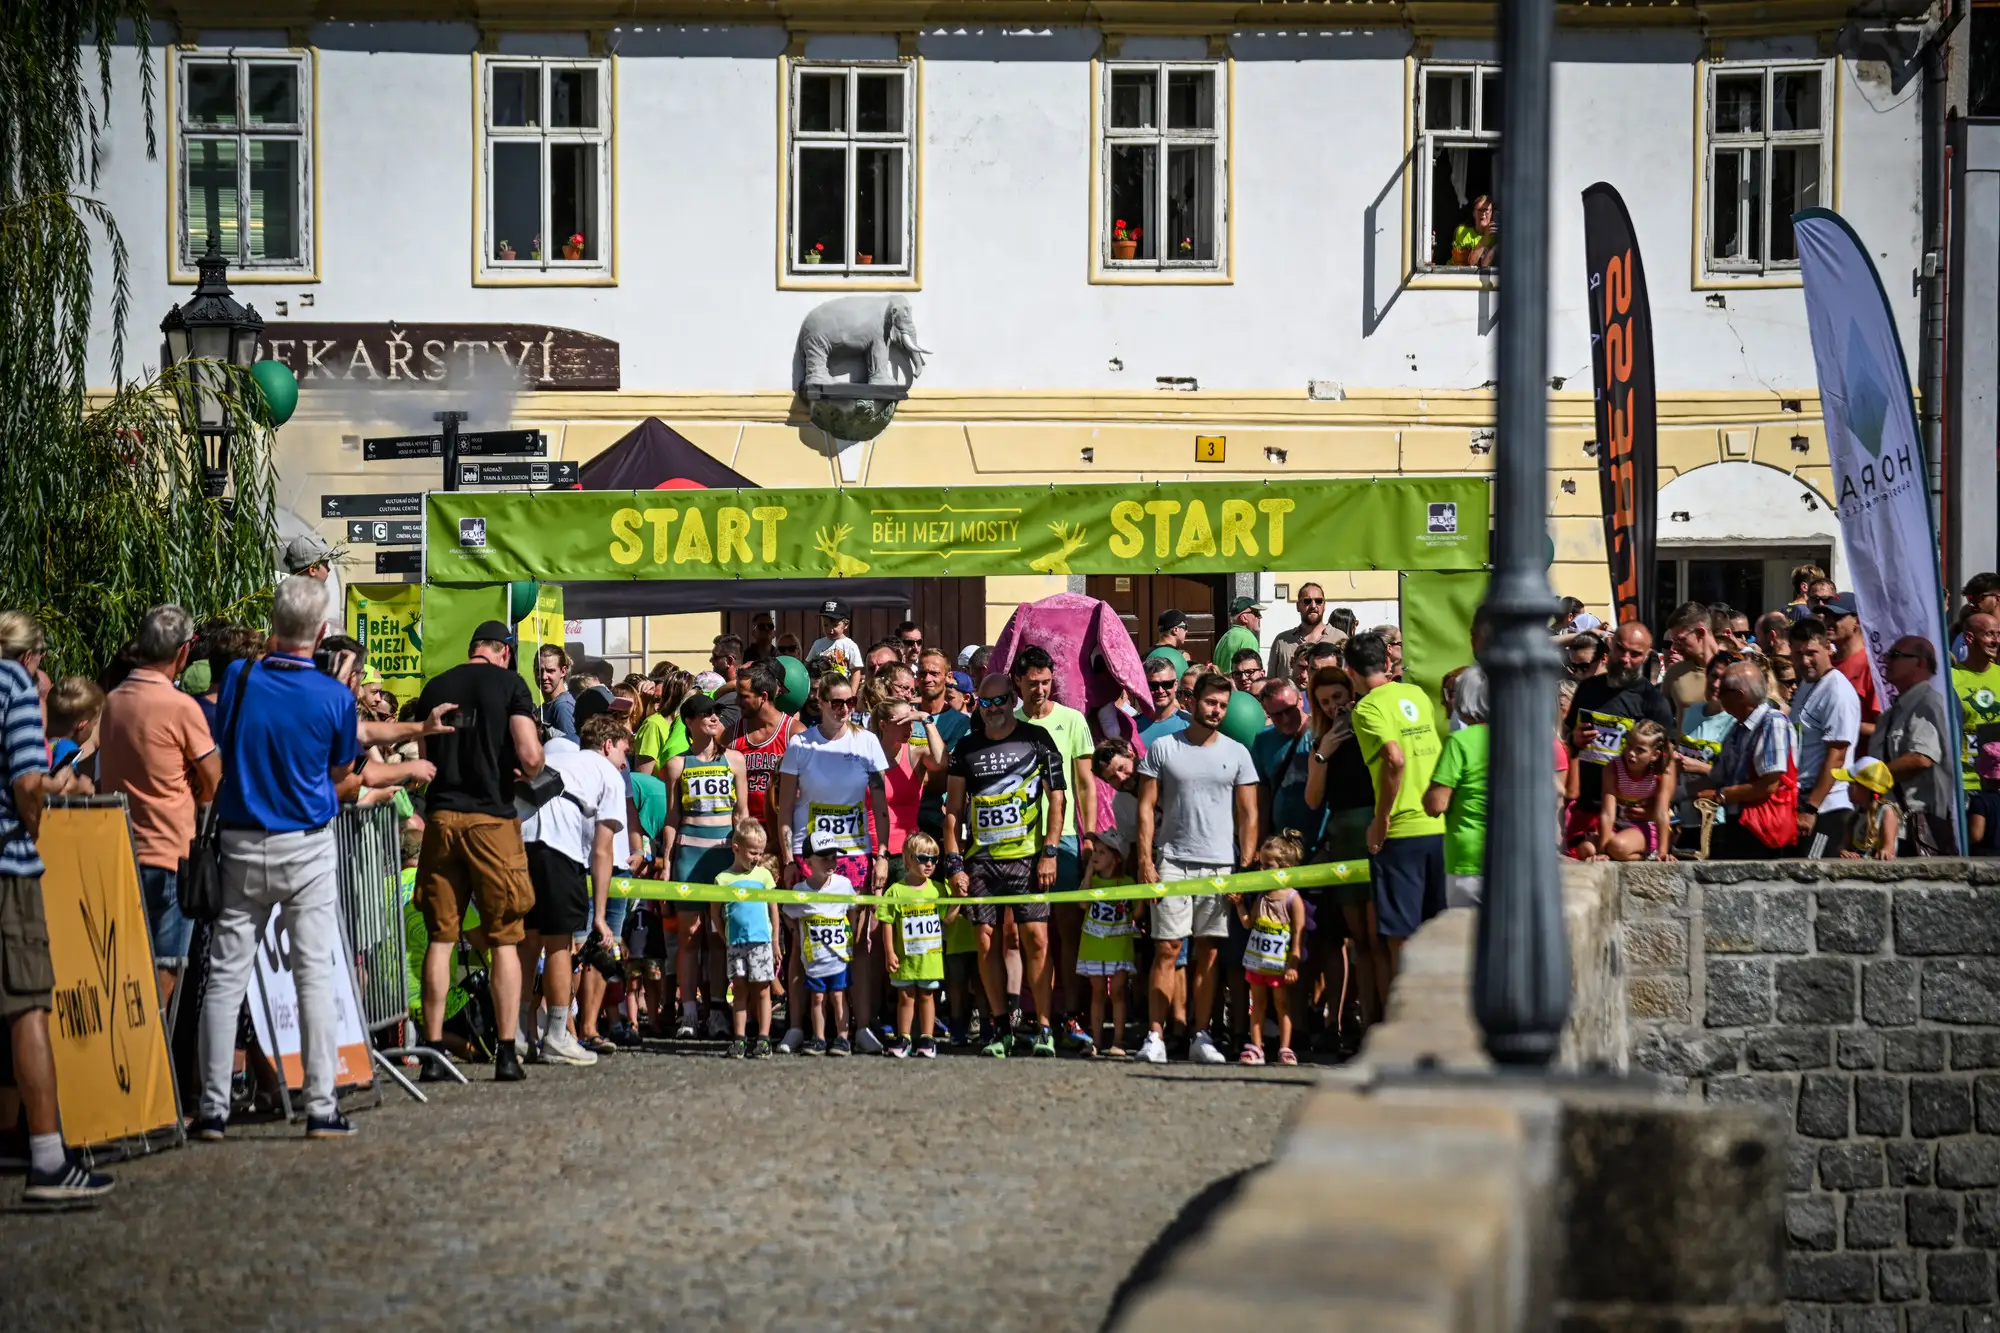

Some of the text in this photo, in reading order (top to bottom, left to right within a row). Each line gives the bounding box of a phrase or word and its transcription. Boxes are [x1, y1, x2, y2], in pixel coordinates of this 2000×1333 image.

[1207, 442, 1215, 456] 3
[375, 524, 386, 538] G
[609, 506, 788, 565] START
[872, 516, 1020, 544] BĚH MEZI MOSTY
[1109, 498, 1295, 559] START
[370, 615, 399, 635] BĚH
[370, 638, 405, 653] MEZI
[370, 655, 419, 671] MOSTY
[745, 752, 780, 770] ICAG
[691, 779, 730, 795] 168
[748, 772, 770, 792] 23
[818, 817, 856, 834] 987
[979, 807, 1018, 827] 583
[905, 920, 940, 935] 1102
